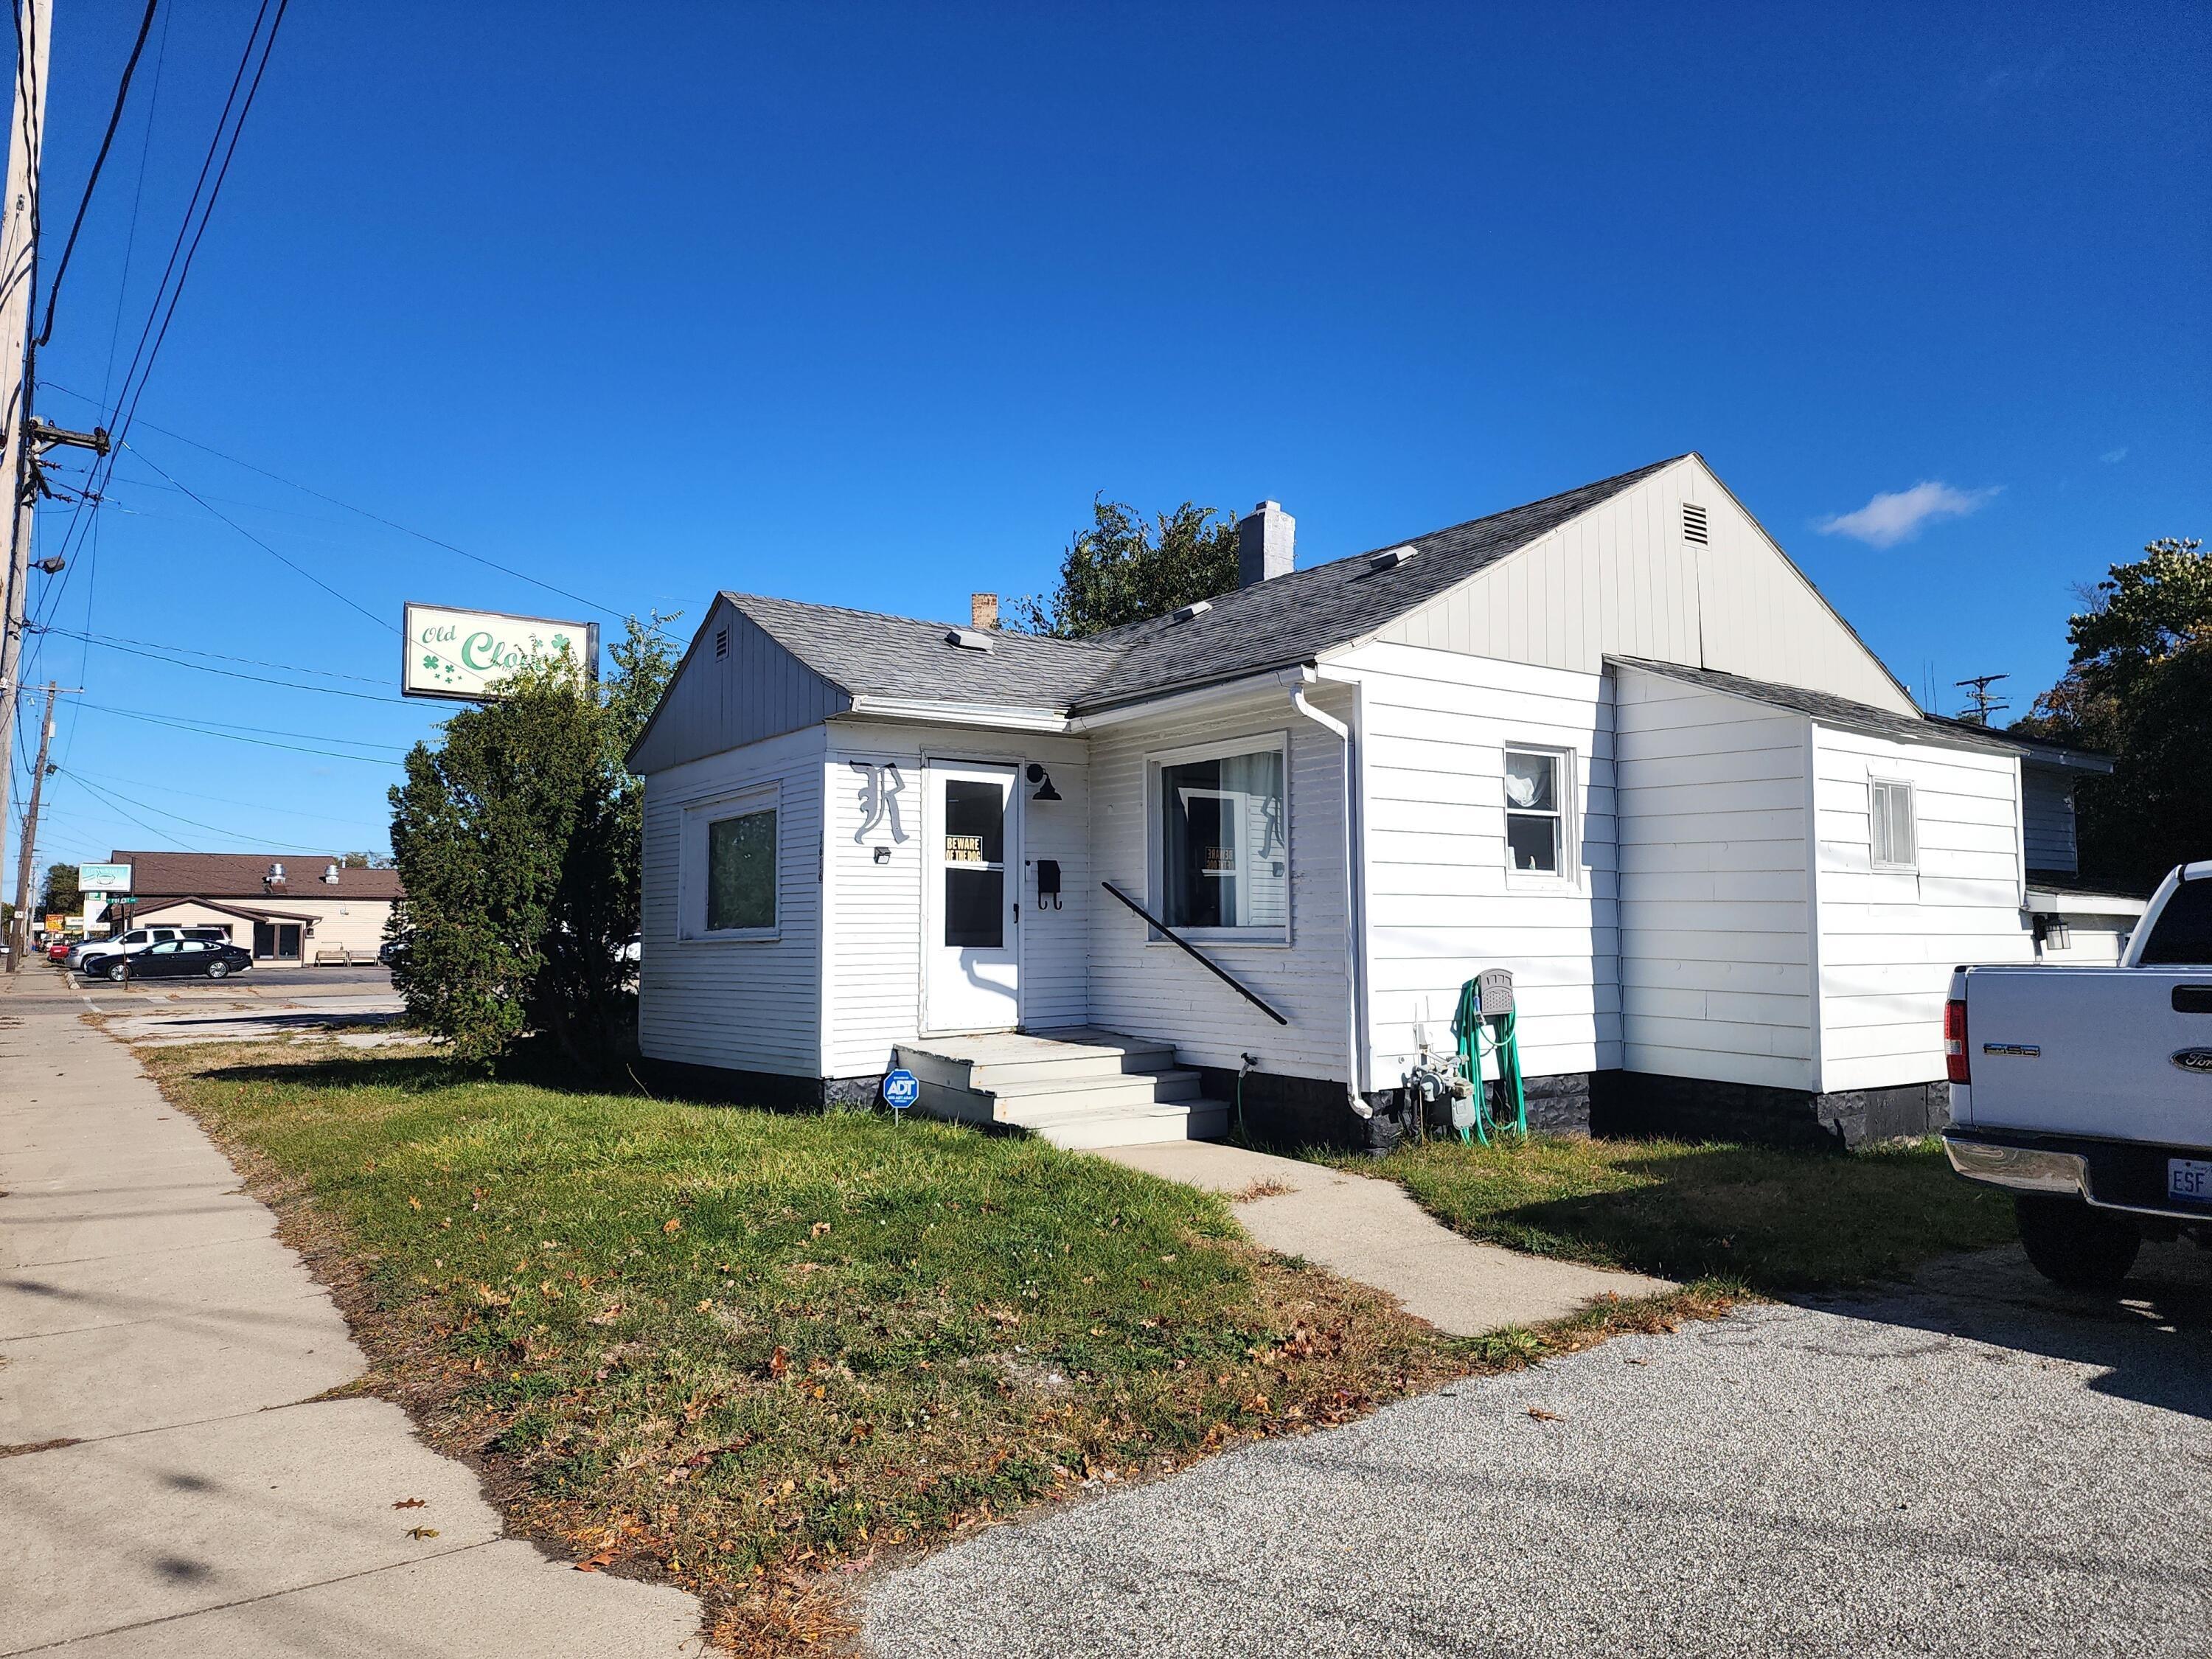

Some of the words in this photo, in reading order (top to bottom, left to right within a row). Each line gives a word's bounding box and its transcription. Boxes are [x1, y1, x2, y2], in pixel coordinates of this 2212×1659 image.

[422, 625, 456, 644] Old
[849, 759, 910, 845] R
[947, 837, 980, 850] BEWARE
[945, 849, 955, 861] OF
[955, 850, 967, 862] THE
[967, 850, 981, 862] DOG
[2185, 1052, 2212, 1066] For
[887, 1080, 915, 1095] ADT
